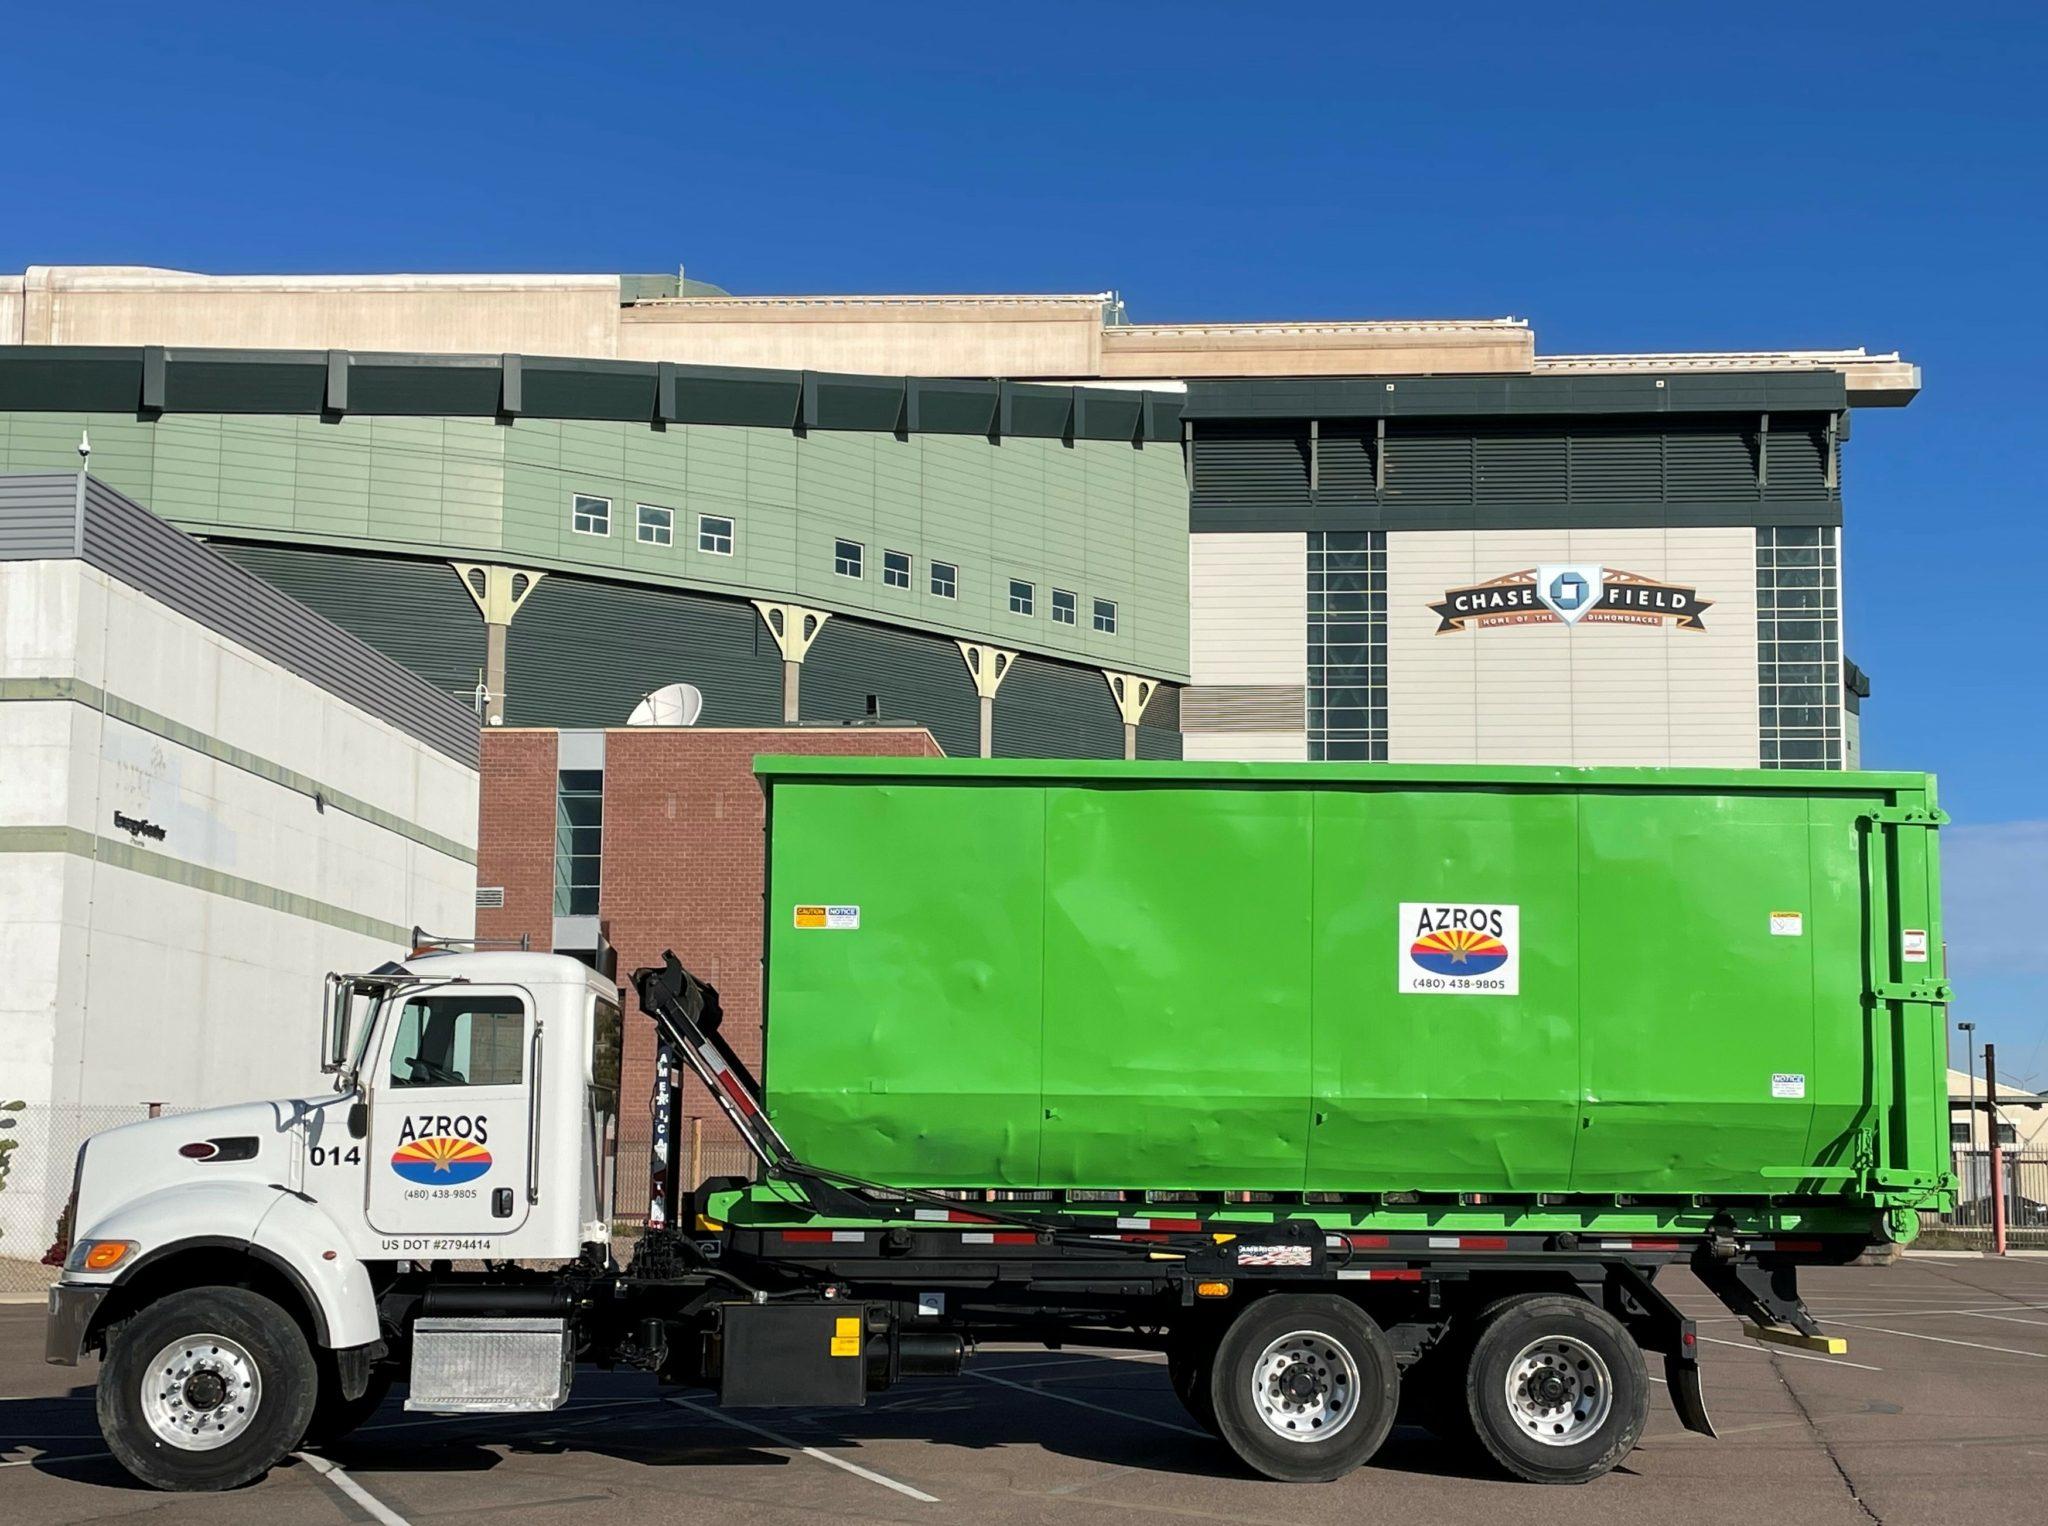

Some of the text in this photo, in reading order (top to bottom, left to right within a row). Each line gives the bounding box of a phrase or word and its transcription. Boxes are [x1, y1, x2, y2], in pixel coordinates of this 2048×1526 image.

[1455, 589, 1687, 611] CHASE FIELD
[1483, 613, 1659, 625] HOME OF THE DIAMONDBACKS
[1416, 907, 1503, 938] AZROS
[1412, 978, 1505, 989] (480) 438-9805
[1774, 1075, 1803, 1083] NOTICE
[398, 1115, 488, 1146] AZROS
[310, 1146, 361, 1167] 014
[404, 1189, 477, 1200] (480) 438-9805
[382, 1240, 491, 1251] US DOT #2794414
